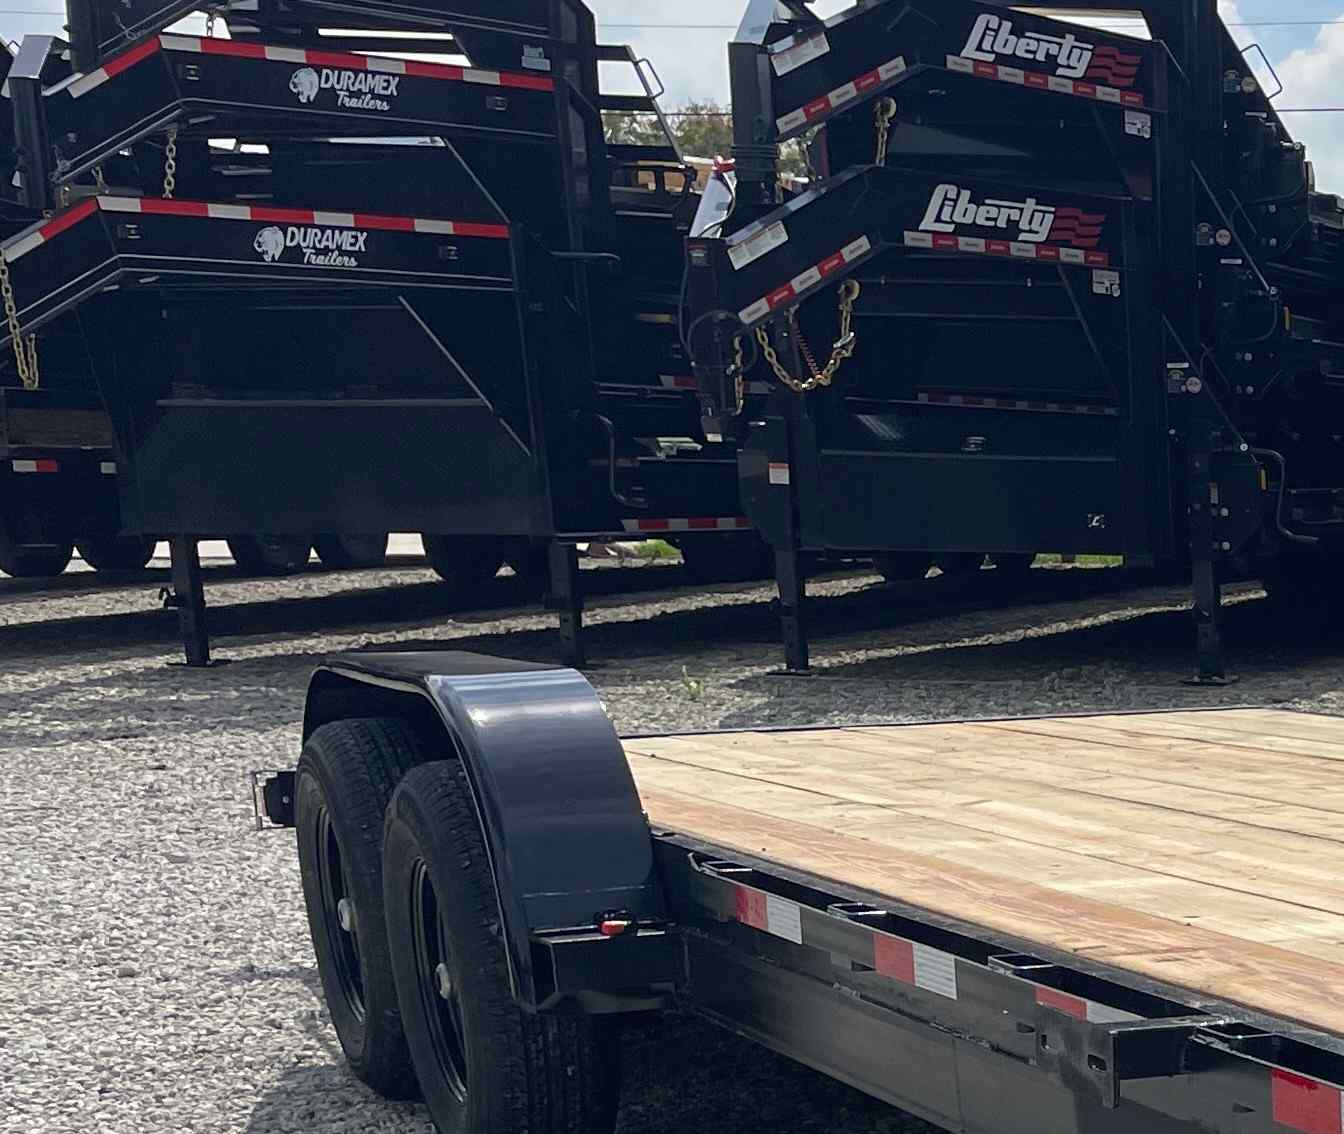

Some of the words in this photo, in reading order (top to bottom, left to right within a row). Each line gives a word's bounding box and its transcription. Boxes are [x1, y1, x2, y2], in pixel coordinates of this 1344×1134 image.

[960, 13, 1095, 78] Liberty
[320, 69, 400, 96] DURAMEX
[336, 91, 390, 111] Trailers
[918, 184, 1056, 242] Liberty
[286, 226, 368, 252] DURAMEX
[302, 248, 358, 267] Trailers
